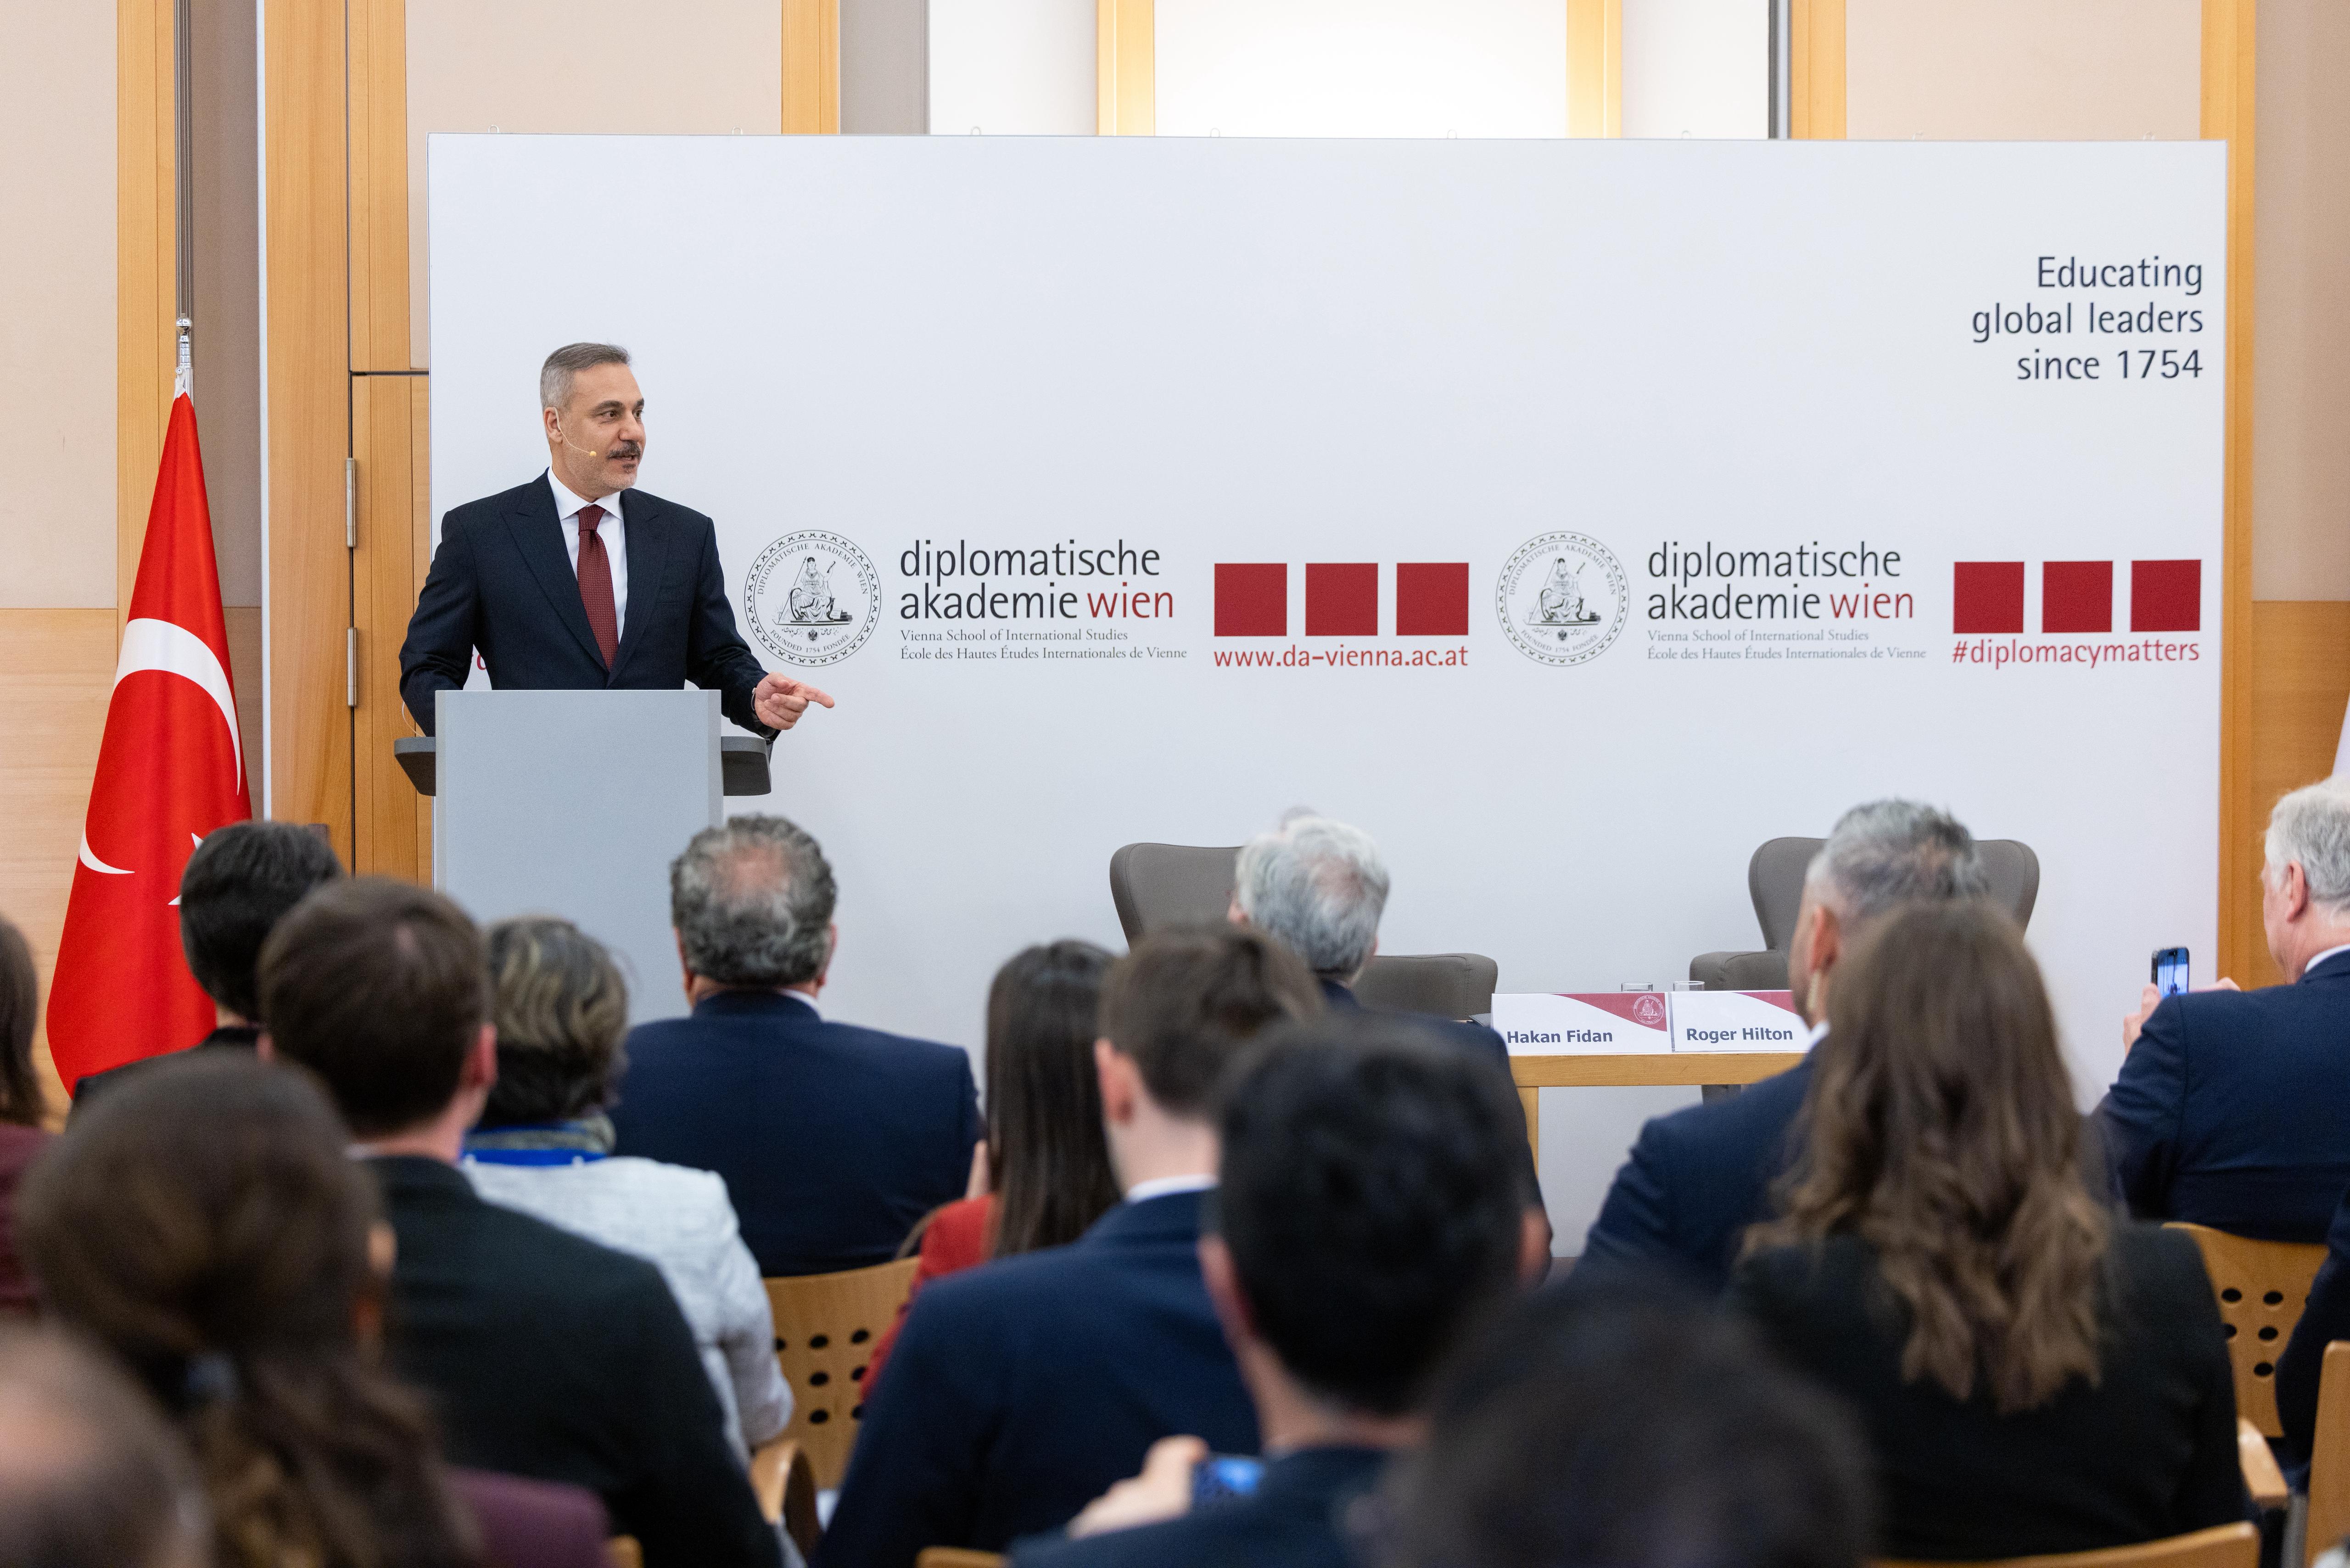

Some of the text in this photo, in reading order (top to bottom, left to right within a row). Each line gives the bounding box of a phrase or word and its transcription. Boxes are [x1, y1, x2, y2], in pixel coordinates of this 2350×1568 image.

[2038, 255, 2202, 296] Educating
[1972, 302, 2203, 343] global leaders
[2017, 348, 2203, 380] since 1754
[757, 543, 868, 594] DIPLOMATISCHE AKADEMIE WIEN
[900, 539, 1160, 587] diplomatische
[1509, 544, 1617, 595] DIPLOMATISCHE AKADEMIE WIEN
[1648, 541, 1901, 588] diplomatische
[900, 582, 1173, 620] akademie wien
[1648, 583, 1913, 620] akademie wien
[771, 630, 801, 651] FOUNDED
[901, 628, 1128, 641] Vienna School of International Studies
[1647, 628, 1869, 641] Vienna School of International Studies
[901, 645, 1187, 659] École des Hautes Études Internationales de Vienne
[1214, 644, 1468, 667] www.da-vienna.ac.at
[1648, 644, 1926, 660] École des Hautes Études Internationales de Vienne
[1952, 638, 2199, 670] #diplomacymatters
[1507, 1029, 1613, 1043] Hakan Fidan
[1686, 1027, 1793, 1044] Roger Hilton
